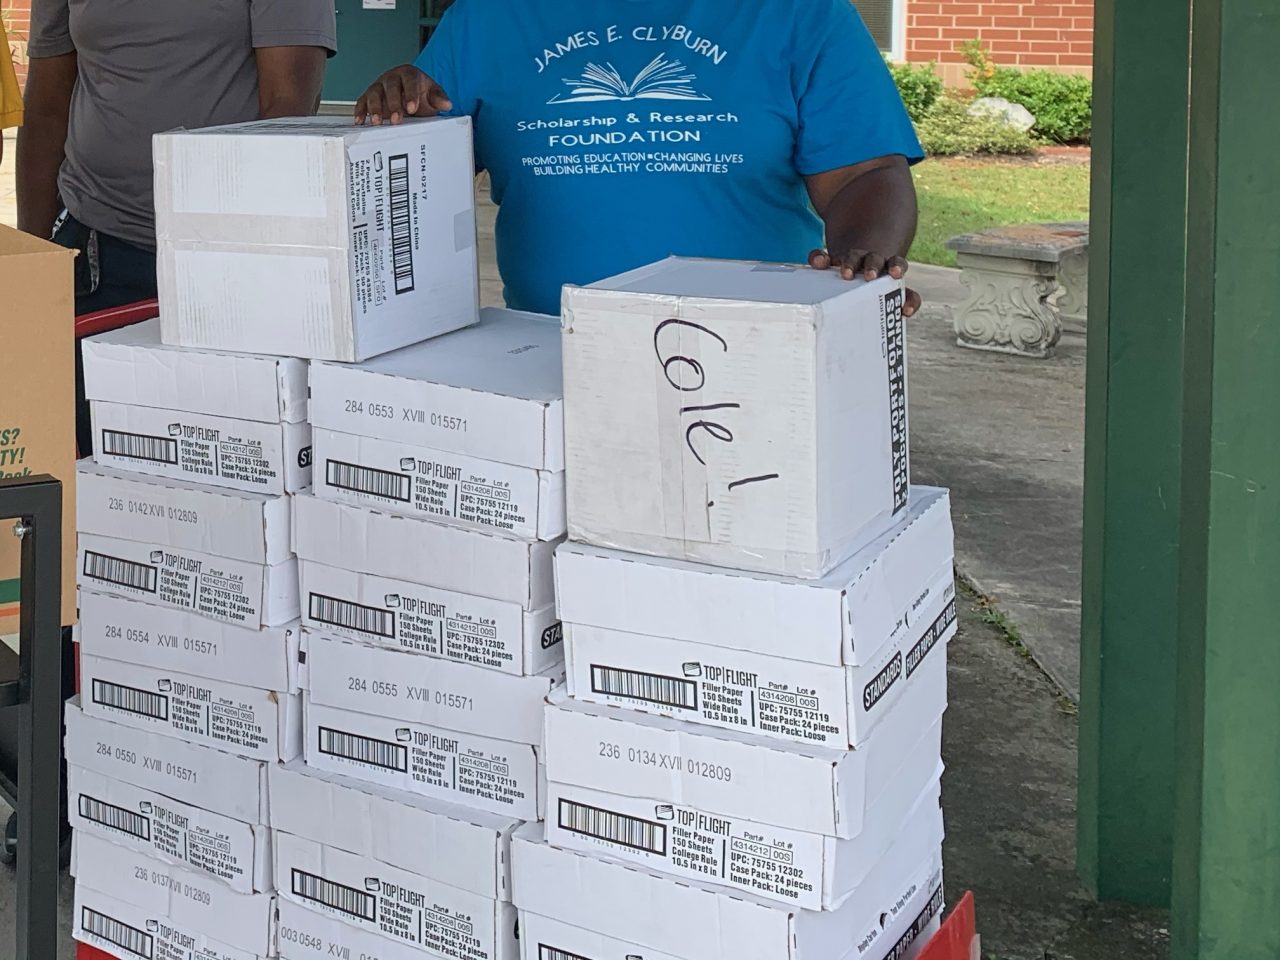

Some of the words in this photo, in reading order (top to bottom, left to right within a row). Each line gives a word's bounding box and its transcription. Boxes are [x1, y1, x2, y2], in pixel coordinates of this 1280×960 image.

[534, 31, 599, 72] JAMES
[607, 25, 621, 42] E.
[633, 25, 726, 64] CLYBURN
[517, 116, 616, 131] Scholarship
[626, 113, 639, 123] &
[650, 112, 738, 123] Research
[549, 130, 700, 147] FOUNDATION
[522, 154, 580, 166] PROMOTING
[715, 154, 743, 163] LIVES
[534, 165, 583, 175] BUILDING
[585, 163, 640, 173] HEALTHY
[646, 162, 728, 173] COMMUNITIES
[893, 295, 902, 360] TANGS
[886, 298, 899, 441] PORTFOLIOS
[345, 401, 363, 413] 284
[369, 404, 393, 418] 0553
[403, 408, 425, 423] XVIII
[431, 413, 468, 432] 015571
[898, 395, 906, 483] POCKETS
[892, 451, 901, 509] POLY
[109, 498, 123, 510] 236
[128, 500, 148, 515] 0142
[148, 504, 164, 517] XVII
[169, 508, 197, 523] 012809
[105, 626, 122, 638] 284
[127, 628, 149, 643] 0554
[157, 633, 178, 648] XVIII
[183, 638, 217, 656] 015571
[702, 682, 720, 692] Filler
[722, 686, 743, 696] Paper
[769, 682, 788, 690] Part#
[797, 687, 808, 695] Lot
[865, 658, 901, 707] STANDARDS
[348, 677, 367, 691] 284
[372, 680, 398, 696] 0555
[406, 686, 429, 702] XVIII
[435, 693, 473, 710] 015571
[703, 692, 716, 701] 150
[718, 694, 742, 706] Sheets
[761, 692, 794, 703] 4314208
[703, 701, 720, 711] Wide
[722, 704, 738, 714] Rule
[759, 702, 777, 713] UPC:
[779, 706, 802, 717] 75755
[805, 710, 829, 722] 12119
[760, 712, 778, 723] Case
[780, 716, 800, 727] Pack:
[802, 720, 811, 728] 24
[813, 722, 839, 733] pieces
[760, 721, 779, 732] Inner
[781, 726, 802, 736] Pack:
[804, 730, 826, 741] Loose
[96, 742, 111, 756] 284
[115, 747, 136, 764] 0550
[143, 755, 161, 772] XVIII
[166, 763, 197, 783] 015571
[599, 742, 620, 759] 236
[628, 747, 656, 767] 0134
[659, 754, 683, 771] XVII
[687, 759, 731, 782] 012809
[672, 837, 686, 848] 150
[688, 841, 712, 854] Sheets
[673, 827, 692, 838] Filler
[694, 832, 714, 844] Paper
[744, 832, 763, 841] Part#
[774, 839, 785, 848] Lot
[672, 847, 699, 861] College
[701, 855, 717, 866] Rule
[734, 841, 768, 855] 4314212
[134, 867, 148, 880] 236
[731, 852, 749, 864] UPC:
[752, 858, 775, 871] 75755
[779, 866, 803, 878] 12302
[731, 863, 749, 875] Case
[751, 869, 772, 881] Pack:
[775, 875, 785, 884] 24
[787, 878, 812, 891] pieces
[731, 873, 750, 885] Inner
[752, 880, 774, 892] Pack:
[776, 886, 798, 898] Loose
[280, 927, 297, 941] 003
[297, 931, 322, 950] 0548
